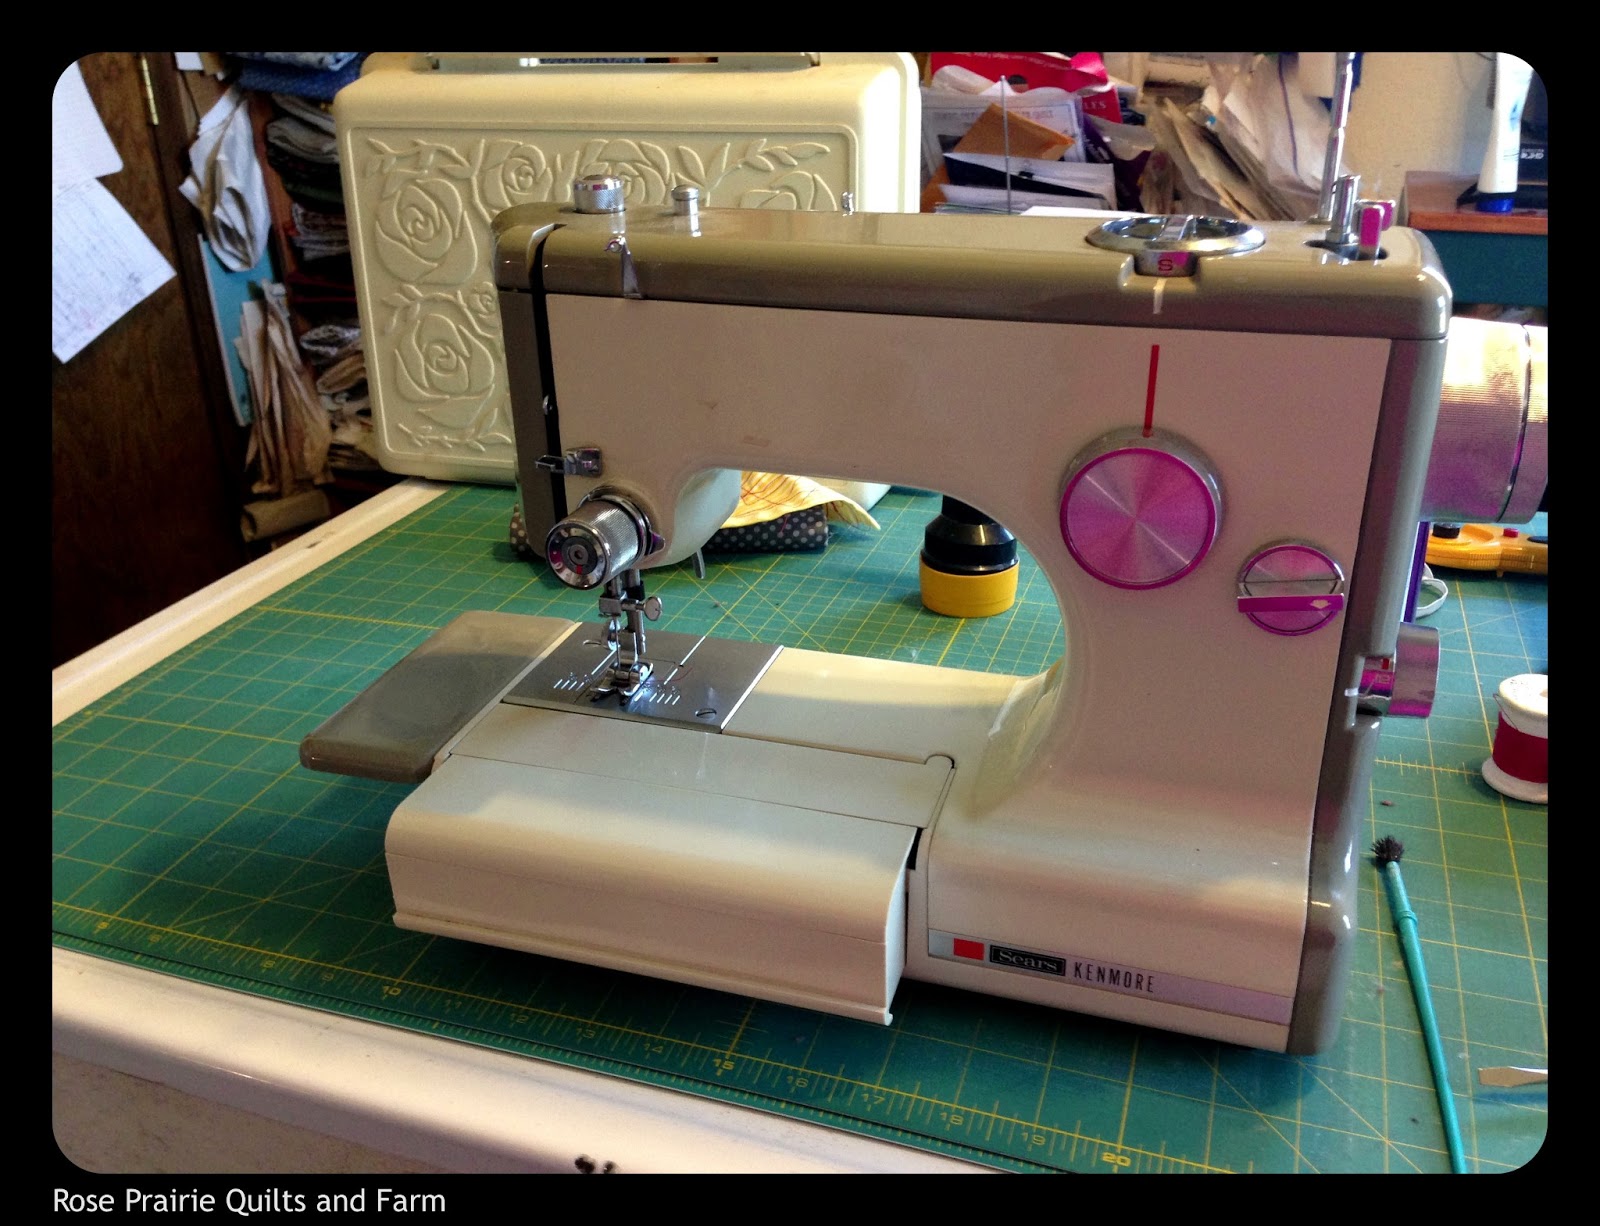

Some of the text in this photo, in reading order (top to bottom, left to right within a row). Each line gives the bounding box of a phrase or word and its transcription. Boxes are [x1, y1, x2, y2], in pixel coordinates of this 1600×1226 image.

[1158, 259, 1174, 272] S
[999, 950, 1156, 993] Sears KENMORE
[382, 985, 402, 997] 10
[510, 1012, 530, 1024] 12
[576, 1027, 597, 1039] 13
[643, 1043, 665, 1054] 14
[713, 1058, 736, 1071] 15
[786, 1075, 810, 1088] 16
[861, 1093, 886, 1105] 17
[940, 1112, 965, 1126] 18
[1021, 1131, 1047, 1146] 19
[1102, 1151, 1132, 1167] 20
